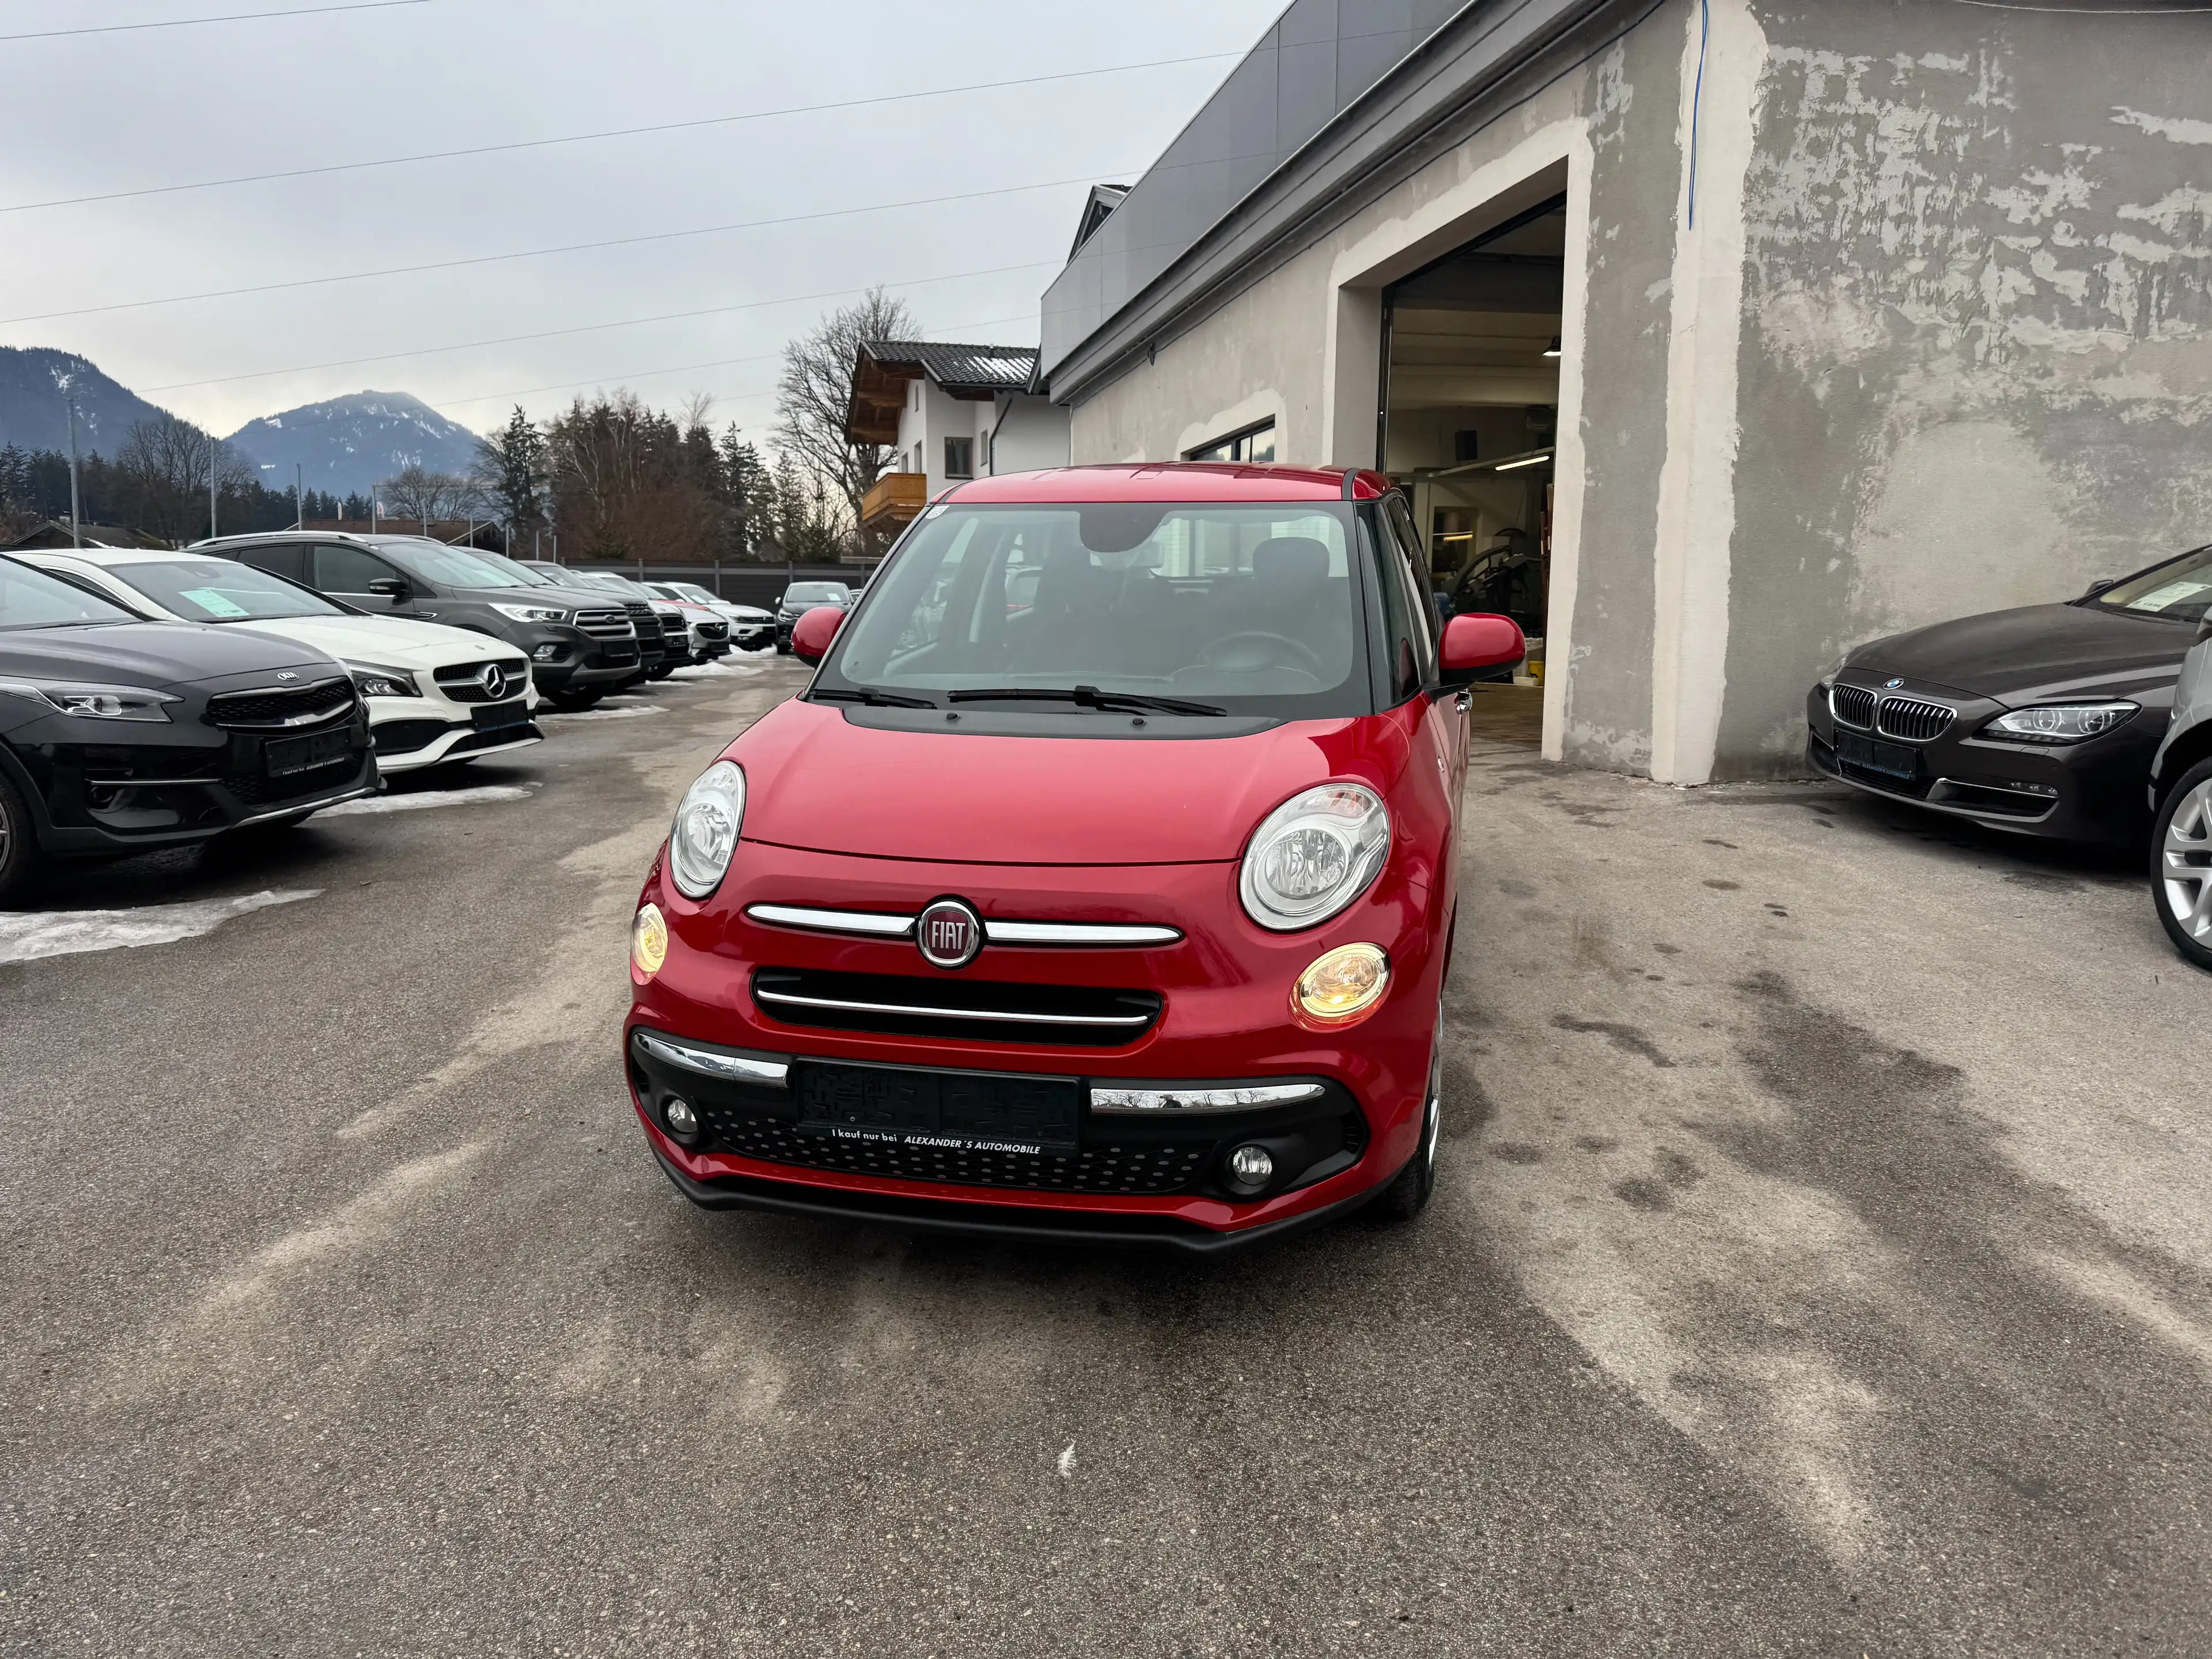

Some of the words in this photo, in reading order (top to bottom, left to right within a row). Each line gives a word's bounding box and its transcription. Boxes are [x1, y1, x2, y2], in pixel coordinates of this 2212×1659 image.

[931, 921, 966, 949] FIAT
[838, 1129, 861, 1138] kauf
[881, 1132, 897, 1142] bei
[974, 1142, 1041, 1154] AUTOMOBILE
